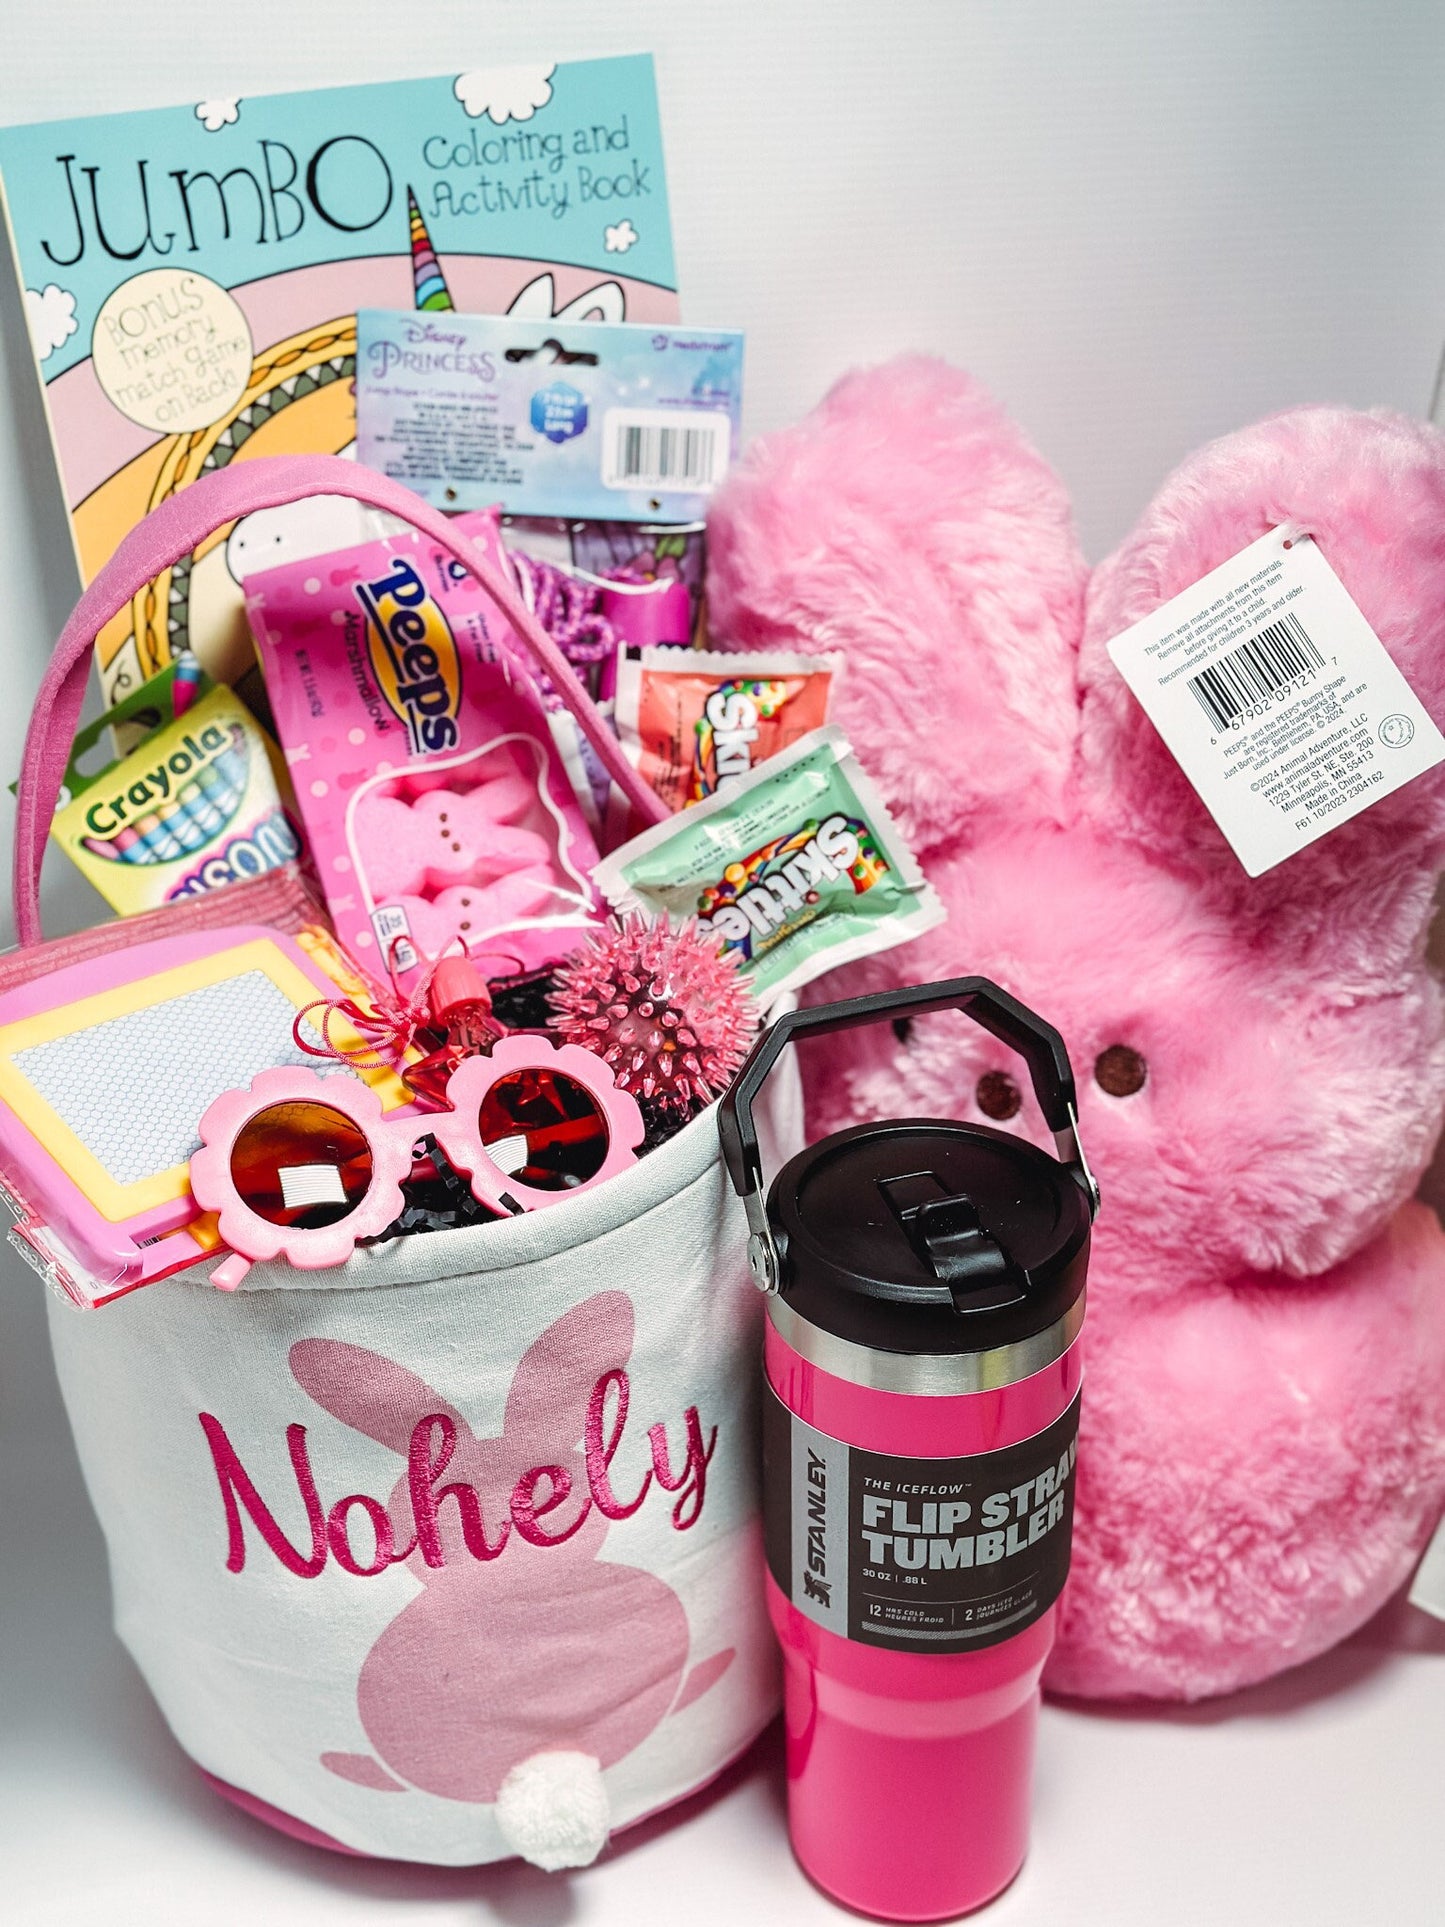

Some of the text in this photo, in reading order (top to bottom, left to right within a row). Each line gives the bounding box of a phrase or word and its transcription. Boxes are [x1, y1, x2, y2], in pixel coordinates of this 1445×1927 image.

[423, 115, 629, 173] Coloring and
[429, 158, 651, 219] Activity Book
[119, 314, 214, 371] memory
[400, 318, 466, 351] Disney
[116, 337, 246, 407] match game
[156, 398, 184, 421] on
[1144, 560, 1284, 656] This item was made with all new materials.
[1158, 574, 1283, 661] Remove all attachments from this item
[1184, 638, 1207, 656] before
[1207, 624, 1229, 643] giving
[1227, 619, 1235, 628] it
[1233, 615, 1242, 623] to
[1248, 597, 1268, 614] child.
[343, 610, 392, 732] Marshmallow
[362, 558, 460, 752] Peeps
[1158, 649, 1209, 686] Recommended
[1208, 643, 1218, 654] for
[1219, 625, 1247, 647] children
[1245, 620, 1253, 628] 3
[1252, 608, 1272, 626] years
[1272, 597, 1286, 611] and
[1211, 656, 1338, 746] 6 67902 09121 7
[1224, 766, 1239, 780] Just
[1237, 756, 1258, 770] Born,
[1272, 722, 1312, 748] Bethlehem,
[1341, 690, 1356, 704] and
[1355, 684, 1368, 695] are
[1243, 691, 1337, 756] are registered trademarks of
[1251, 728, 1265, 742] and
[1264, 722, 1277, 733] the
[1301, 690, 1325, 708] Bunny
[1323, 676, 1347, 694] Shape
[1252, 756, 1270, 771] used
[1270, 744, 1290, 760] under
[1289, 728, 1317, 747] license.
[1262, 728, 1369, 799] www.animaladventure.com
[1269, 736, 1375, 808] 1229 Tyler St. NE, Ste. 200
[1281, 751, 1309, 775] Animal
[1309, 727, 1353, 757] Adventure,
[1350, 713, 1368, 729] LLC
[86, 725, 227, 834] Crayola
[1281, 750, 1375, 814] Minneapolis, MN 55413
[1295, 771, 1385, 831] F61 10/2023 2304162
[1305, 773, 1363, 812] Made in China
[199, 1368, 718, 1579] Nohely
[864, 1477, 891, 1491] THE
[861, 1489, 1065, 1570] TUMBLER
[863, 1494, 972, 1534] FLIP
[862, 1568, 876, 1578] 30
[878, 1572, 891, 1581] OZ
[921, 1577, 927, 1585] L
[869, 1604, 882, 1617] 12
[904, 1609, 925, 1617] COLD
[965, 1609, 973, 1621] 2
